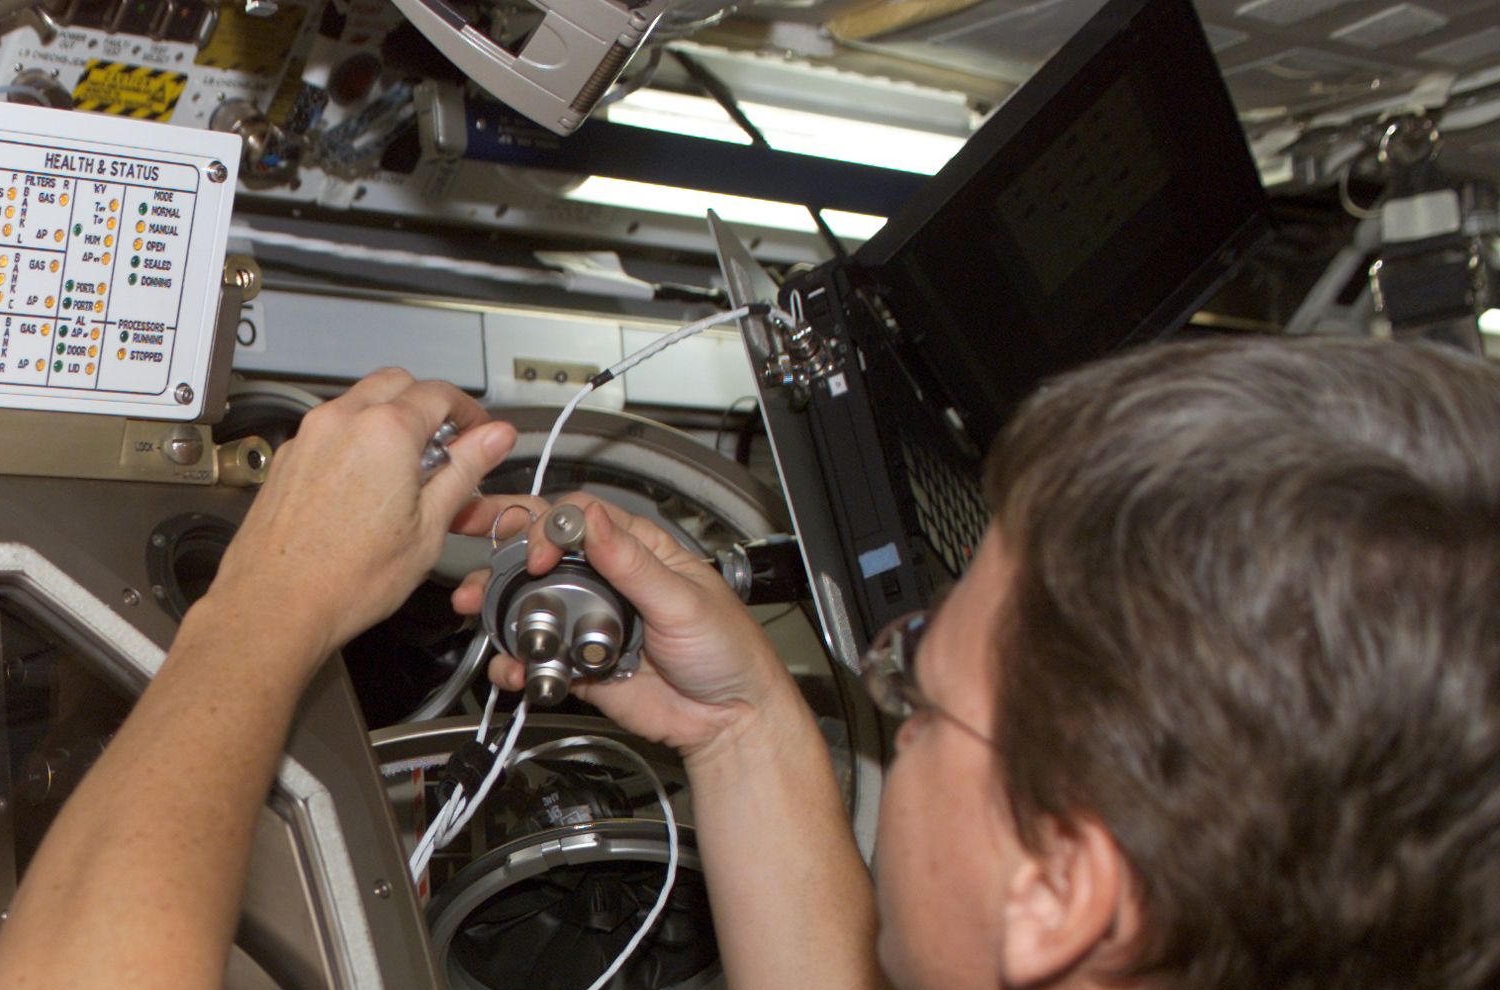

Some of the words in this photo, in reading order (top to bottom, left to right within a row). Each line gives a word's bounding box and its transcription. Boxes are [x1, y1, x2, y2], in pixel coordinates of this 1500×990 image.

[44, 153, 95, 173] HEALTH
[97, 161, 106, 175] &
[110, 163, 160, 181] STATUS
[12, 173, 18, 183] F
[25, 175, 57, 188] FILTERS
[63, 180, 70, 190] R
[38, 192, 56, 204] GAS
[153, 191, 174, 202] MODE
[151, 206, 180, 219] NORMAL
[148, 223, 179, 236] MANUAL
[84, 234, 101, 246] HUM
[146, 241, 166, 252] OPEN
[29, 259, 46, 271] GAS
[143, 258, 172, 271] SEALED
[141, 276, 172, 288] DONNING
[75, 316, 86, 326] AL
[118, 319, 165, 333] PROCESSORS
[20, 323, 37, 335] GAS
[132, 333, 163, 346] RUNNING
[66, 344, 87, 357] DOOR
[129, 350, 163, 363] STOPPED
[68, 363, 80, 374] LID
